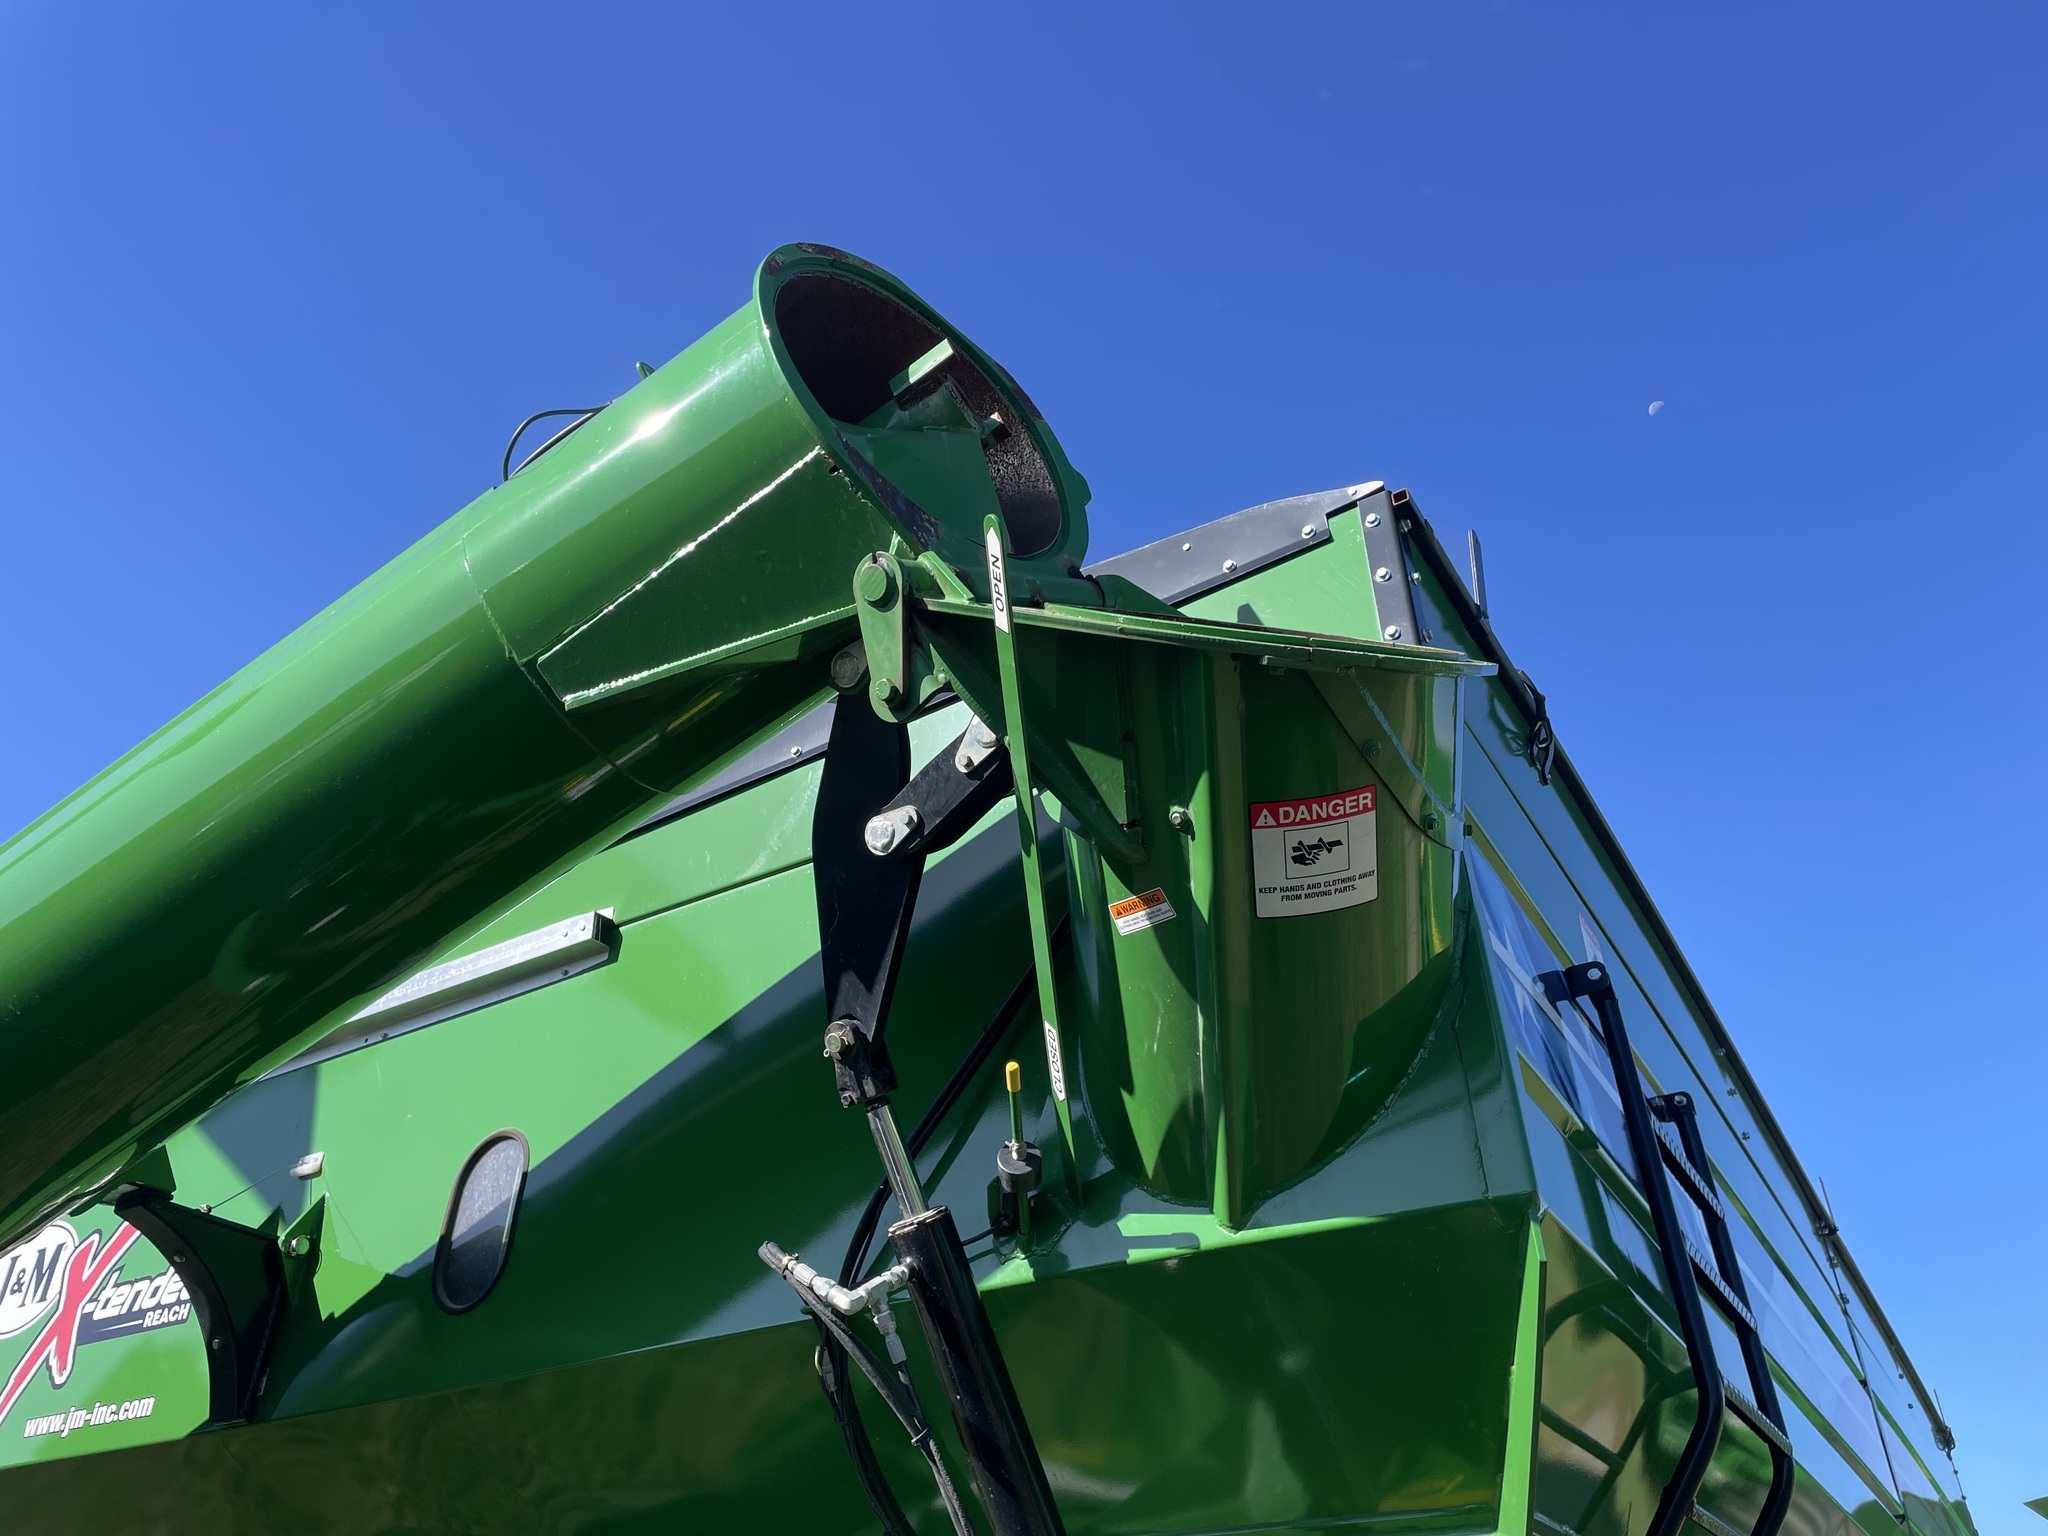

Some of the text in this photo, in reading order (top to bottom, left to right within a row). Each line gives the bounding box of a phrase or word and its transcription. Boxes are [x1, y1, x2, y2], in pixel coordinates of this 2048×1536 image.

[990, 553, 1005, 613] OPEN
[1278, 792, 1373, 824] DANGER
[1258, 869, 1376, 895] KEEP HANDS AND CLOTHING AWAY
[1281, 884, 1358, 902] FROM MOVING PARTS.
[1120, 893, 1161, 914] WARNING
[1047, 1028, 1063, 1094] CLOSED
[0, 1241, 67, 1309] J&M
[143, 1302, 191, 1328] REACH
[23, 1396, 155, 1438] www.jm-inc.com
